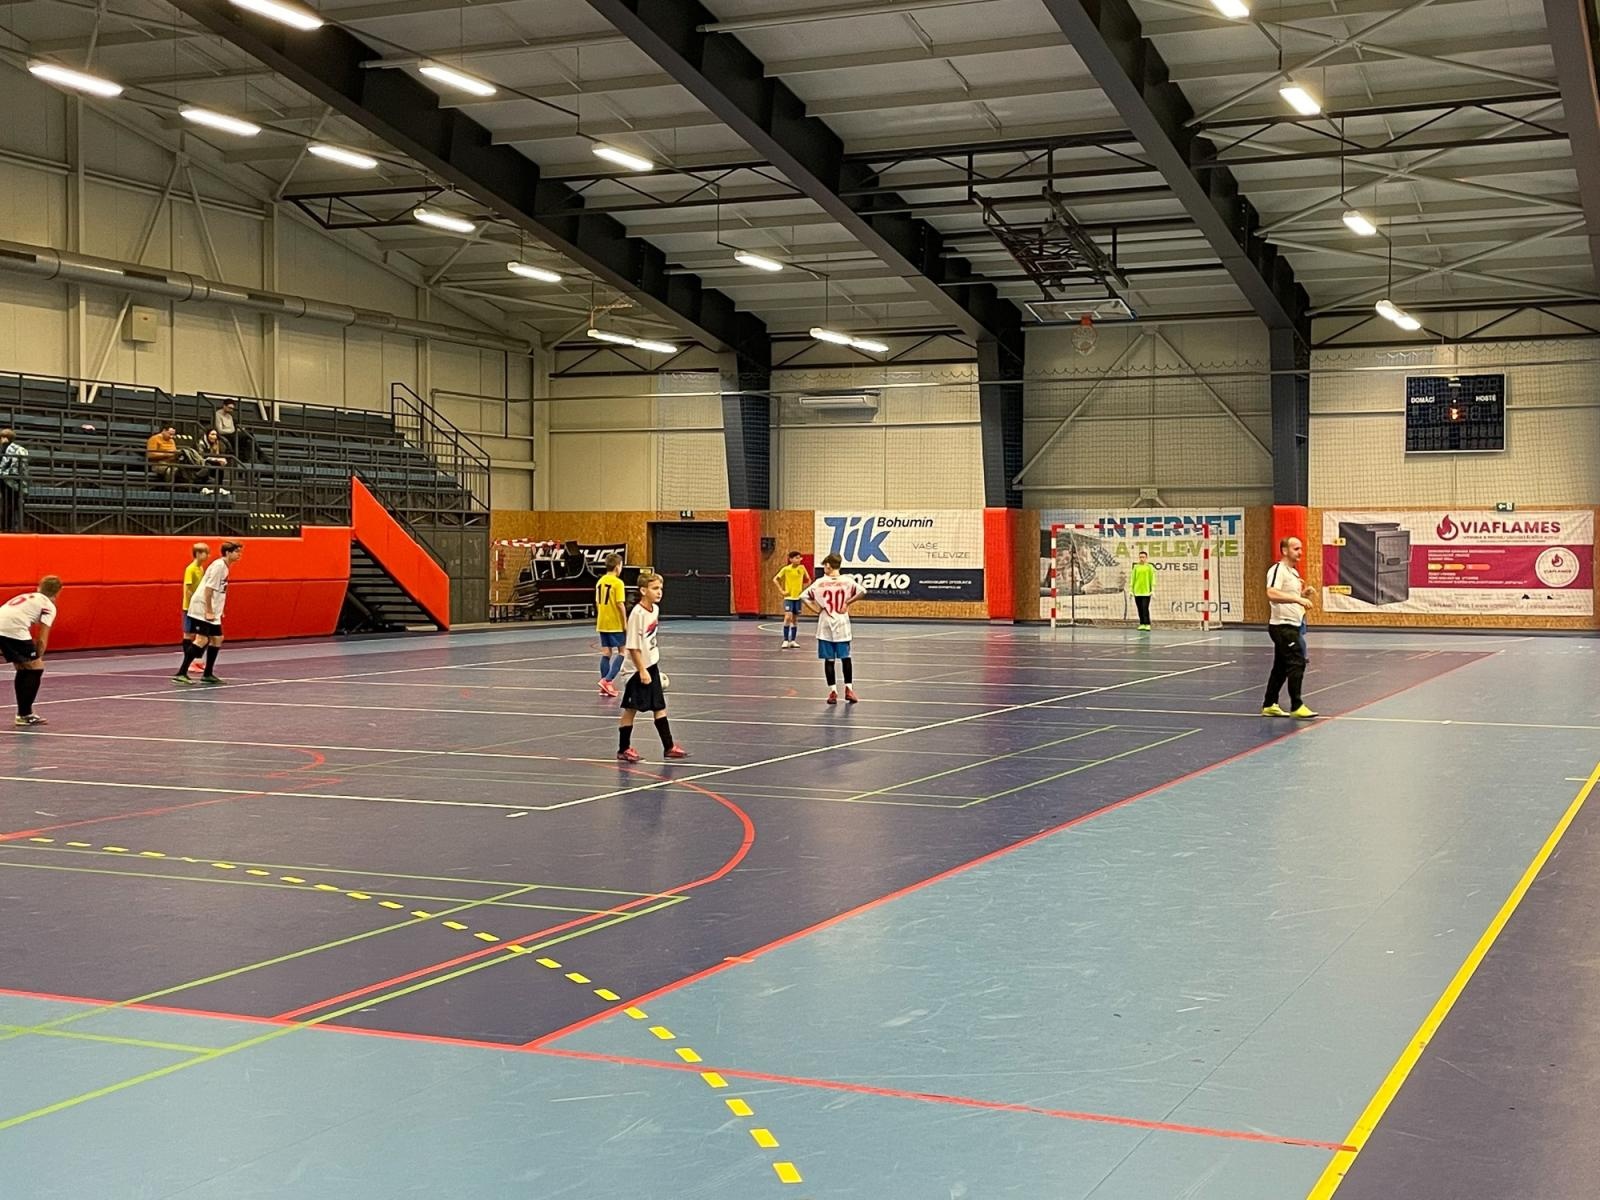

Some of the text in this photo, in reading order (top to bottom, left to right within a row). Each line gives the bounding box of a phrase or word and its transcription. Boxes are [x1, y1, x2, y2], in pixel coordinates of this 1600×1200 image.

[1475, 394, 1496, 402] HOSTÉ
[1460, 521, 1561, 534] VIAFLAMES
[912, 541, 938, 550] VAŠE
[1135, 540, 1238, 557] TELEVZE
[926, 551, 970, 559] TELEVIZE
[598, 583, 611, 605] 17
[823, 589, 845, 614] 30
